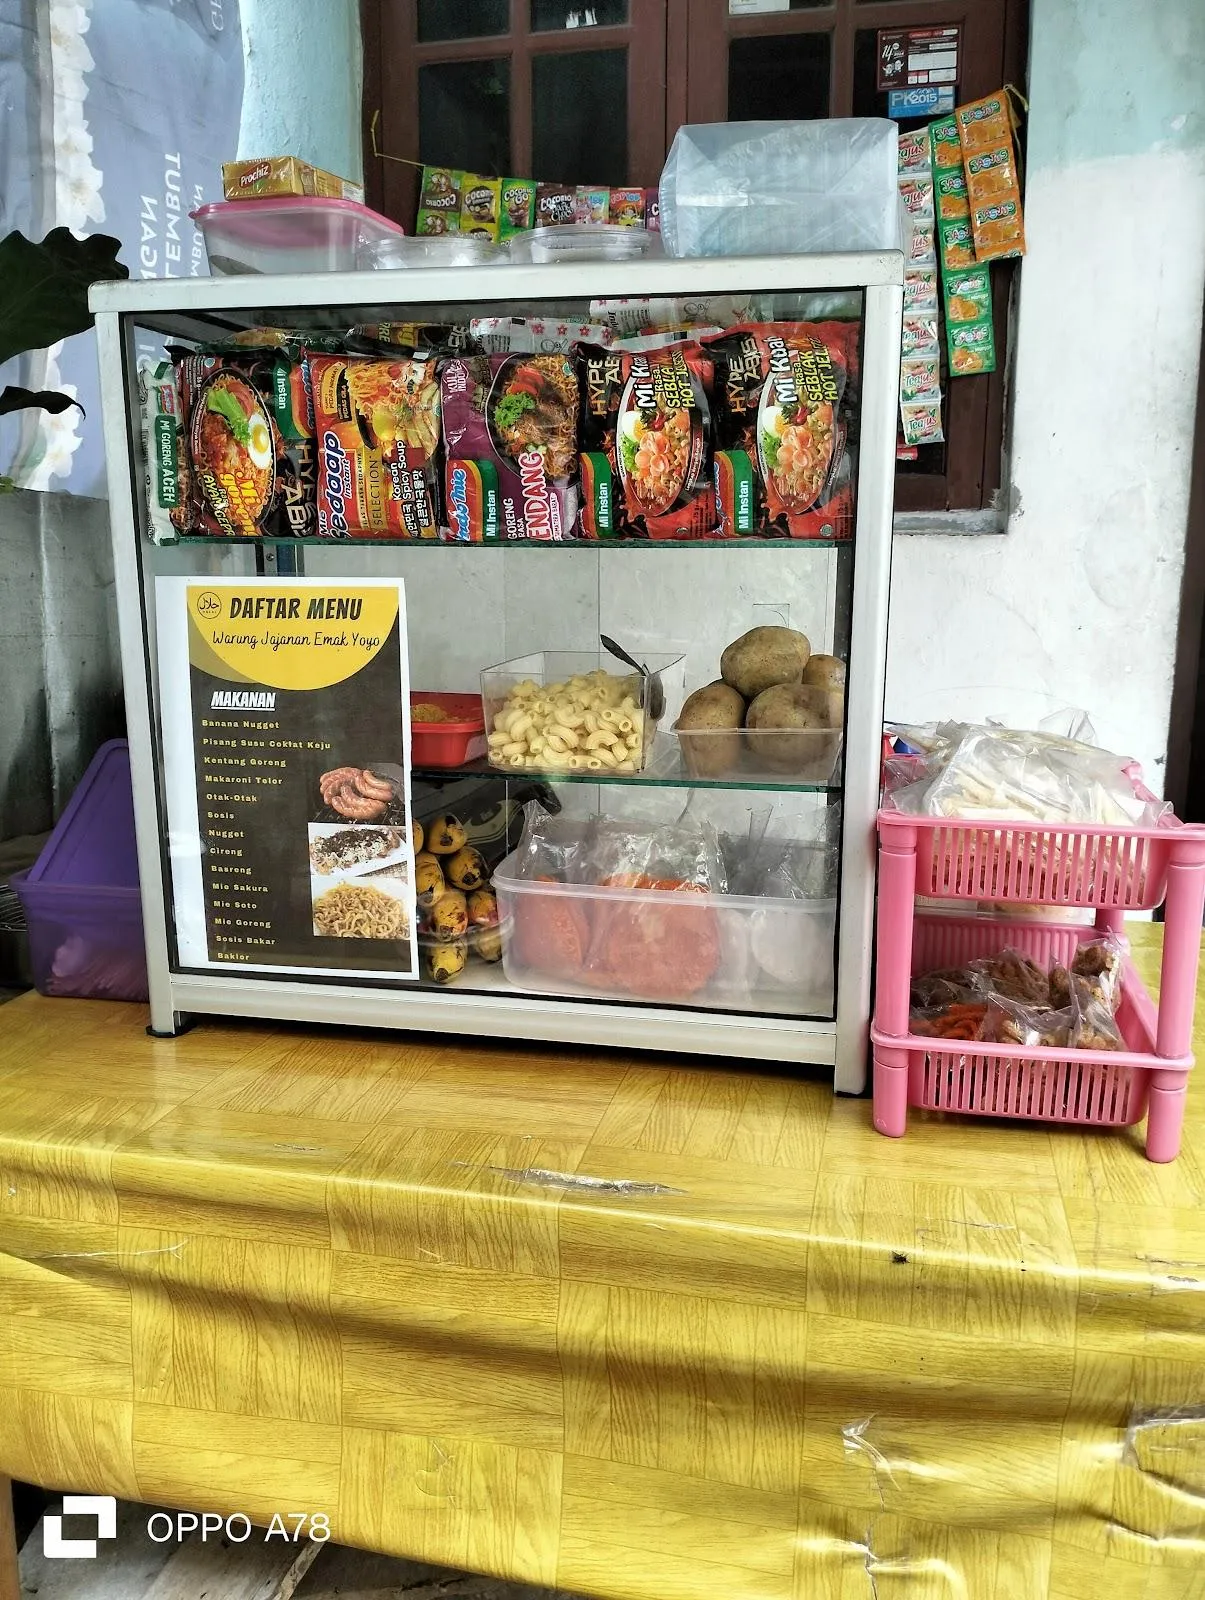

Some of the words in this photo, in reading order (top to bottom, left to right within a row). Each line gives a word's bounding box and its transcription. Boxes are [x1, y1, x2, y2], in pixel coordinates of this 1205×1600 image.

[240, 164, 269, 187] Prochiz
[653, 368, 664, 391] Rasa
[727, 358, 746, 413] HYPE
[792, 362, 805, 386] Rasa
[799, 350, 824, 401] SEBLAK
[276, 378, 287, 409] Instan
[588, 359, 607, 416] HYPE
[636, 383, 657, 408] Mi
[678, 378, 696, 408] HOT
[773, 379, 797, 403] Mi
[819, 371, 839, 401] HOT
[160, 420, 170, 431] MI
[160, 433, 173, 466] GORENG
[397, 440, 407, 468] Soup
[162, 468, 175, 503] ACEH
[370, 460, 383, 525] SELECTION
[390, 462, 402, 500] Korean
[401, 470, 413, 500] Spicy
[486, 490, 496, 523] Instan
[599, 483, 609, 515] Instan
[738, 481, 749, 514] Instan
[503, 498, 517, 540] GORENG
[518, 517, 526, 538] RASA
[599, 516, 609, 527] Mi
[738, 516, 749, 529] Mi
[486, 525, 496, 537] Mi
[229, 597, 301, 619] DAFTAR
[306, 598, 363, 620] MENU
[212, 630, 259, 650] Warung
[261, 631, 311, 652] Jajanan
[313, 631, 349, 647] Emak
[351, 633, 380, 651] Yoyo
[210, 690, 277, 709] MAKANAN
[202, 720, 239, 728] Banana
[243, 721, 280, 730] Nugget
[203, 738, 237, 747] Pisang
[241, 739, 265, 747] Susu
[269, 740, 303, 749] Coklat
[307, 741, 331, 750] Keju
[204, 757, 246, 766] Kentang
[250, 758, 287, 768] Goreng
[205, 775, 251, 784] Makaroni
[255, 776, 283, 785] Telor
[206, 793, 258, 802] Otak-Otak
[207, 811, 235, 819] Sosis
[208, 829, 244, 839] Nugget
[210, 847, 243, 857] Cireng
[211, 865, 252, 875] Basreng
[212, 883, 230, 891] Mie
[233, 884, 268, 893] Sakura
[235, 901, 257, 909] Soto
[215, 918, 232, 926] Mie
[236, 919, 271, 929] Goreng
[216, 935, 243, 944] Sosis
[246, 936, 276, 946] Bakar
[217, 952, 250, 961] Baklor
